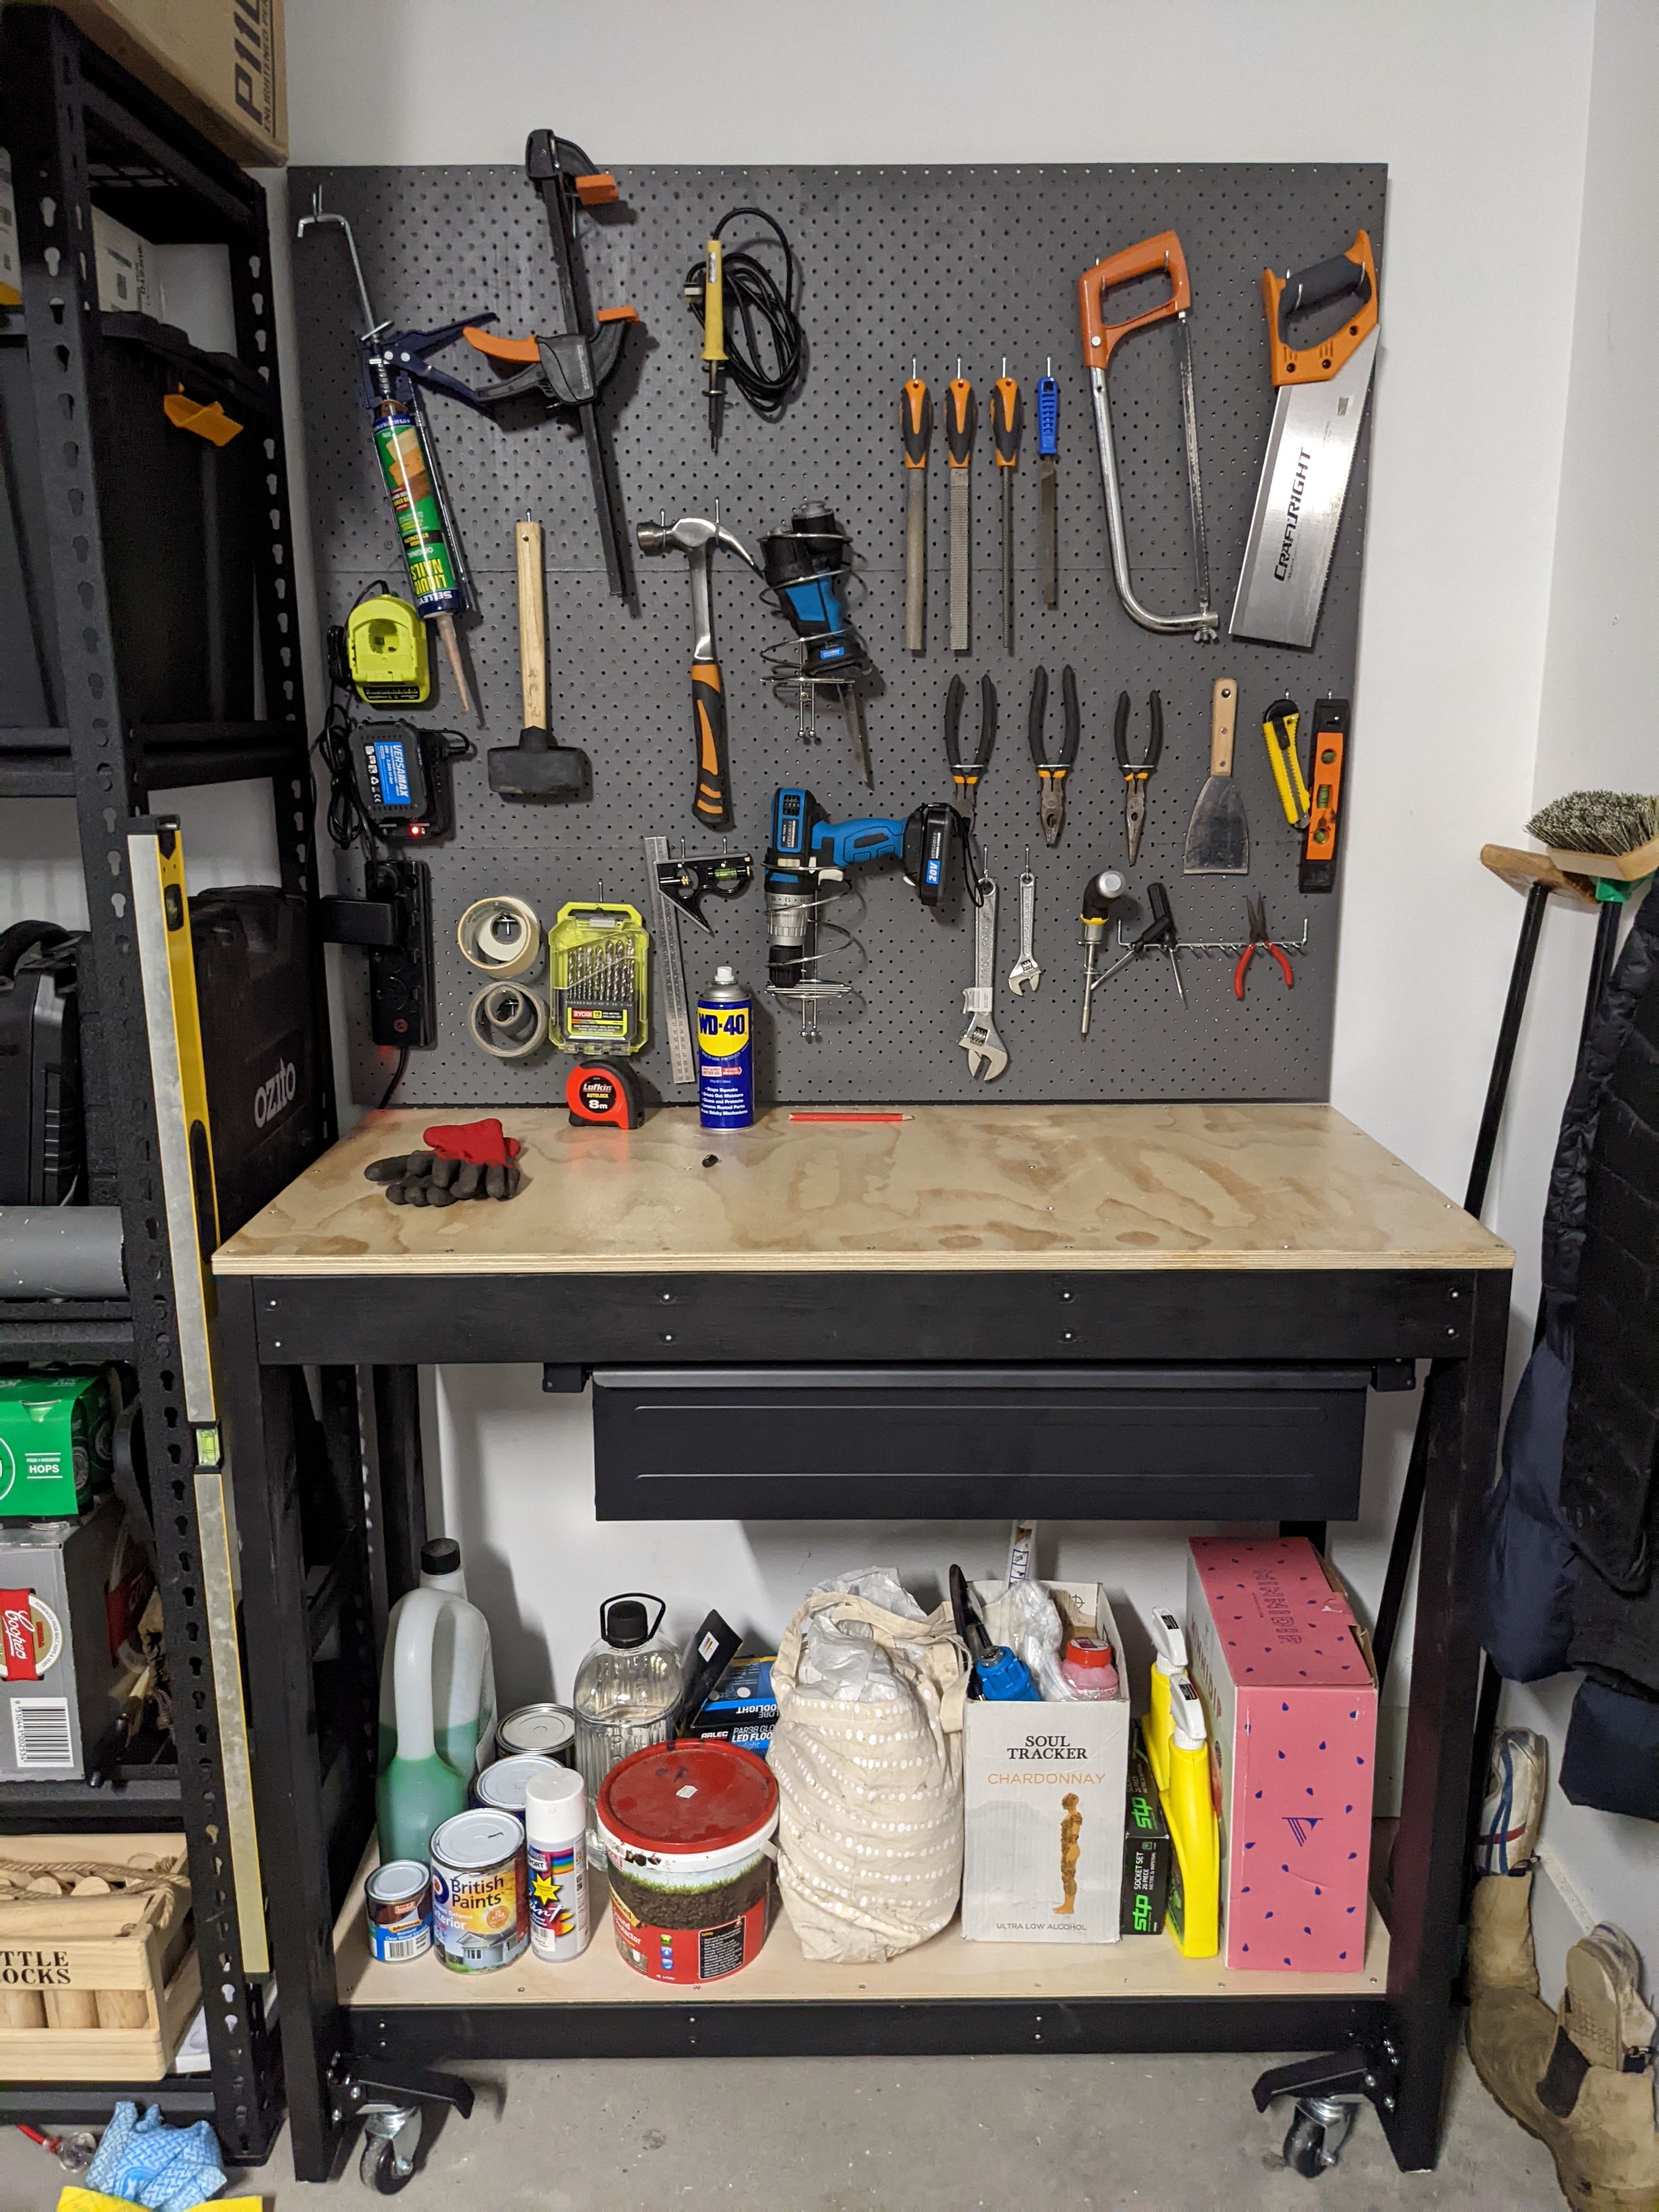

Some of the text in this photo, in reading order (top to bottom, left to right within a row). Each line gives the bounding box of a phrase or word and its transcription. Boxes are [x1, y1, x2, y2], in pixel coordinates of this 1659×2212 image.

[1274, 446, 1312, 582] CRAFTRIGHT
[408, 547, 433, 558] ORGINAL
[410, 558, 443, 580] NAILS
[393, 744, 408, 797] VERSAMAX
[928, 862, 938, 882] 20V
[699, 1013, 745, 1035] WD-40
[721, 1051, 741, 1061] PRODUCT
[255, 1058, 296, 1127] ozito
[29, 1465, 59, 1473] HOPS
[4, 1610, 35, 1660] Coopers
[731, 1734, 749, 1743] LED
[733, 1725, 759, 1735] PAR38
[1025, 1735, 1070, 1747] SOUL
[1007, 1747, 1088, 1759] TRACKER
[988, 1773, 1105, 1784] CHARDONNAY
[1131, 1797, 1153, 1830] stp
[1133, 1851, 1144, 1891] SOCKET SET
[451, 1875, 504, 1895] British
[452, 1893, 502, 1909] Paints
[1132, 1894, 1152, 1932] stp
